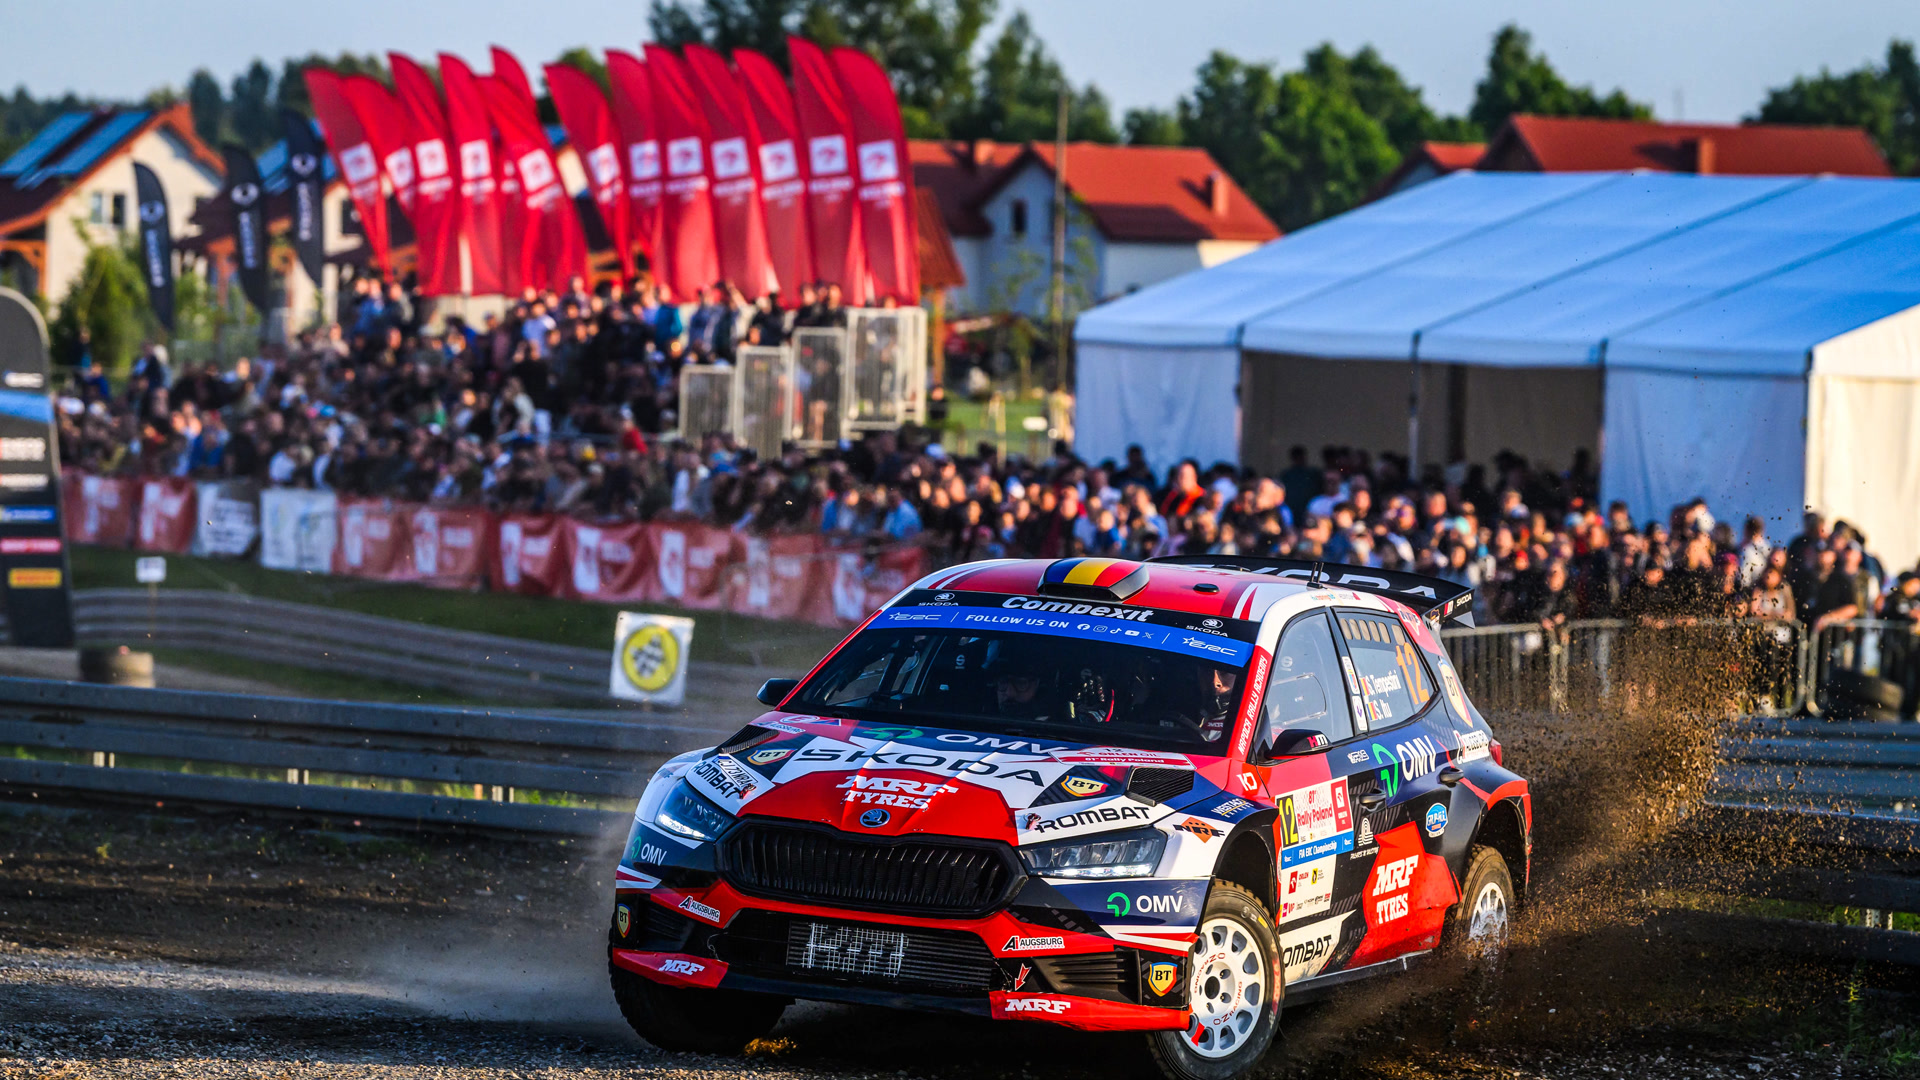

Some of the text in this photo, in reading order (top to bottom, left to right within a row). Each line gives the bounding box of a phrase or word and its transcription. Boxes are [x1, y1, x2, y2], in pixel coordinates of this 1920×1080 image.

[1002, 597, 1154, 622] Compexit
[965, 614, 1069, 628] FOLLOW US ON
[1396, 642, 1430, 705] 12
[1237, 717, 1252, 755] NAPOCA
[1246, 691, 1260, 721] RALLY
[936, 733, 1069, 755] OMV
[793, 748, 1044, 788] SKODA
[1396, 735, 1437, 781] OMV
[691, 761, 742, 799] ROMBAT
[836, 775, 959, 796] MRF
[1072, 780, 1099, 790] BT
[842, 790, 932, 809] TYRES
[1036, 806, 1151, 833] ROMBAT
[1279, 798, 1298, 845] 12
[1297, 812, 1312, 829] Rally
[1312, 803, 1333, 822] Poland
[1173, 824, 1225, 837] NRF
[641, 843, 668, 866] OMV
[1372, 854, 1419, 896] MRF
[691, 900, 720, 918] AUGSBURG
[1136, 895, 1183, 913] OMV
[1376, 892, 1409, 924] TYRES
[620, 911, 628, 923] BT
[1020, 937, 1063, 947] AUGSBURG
[1283, 935, 1332, 968] OMBAT
[658, 959, 705, 976] MRF
[1155, 969, 1172, 982] BT
[1004, 998, 1071, 1014] MRF
